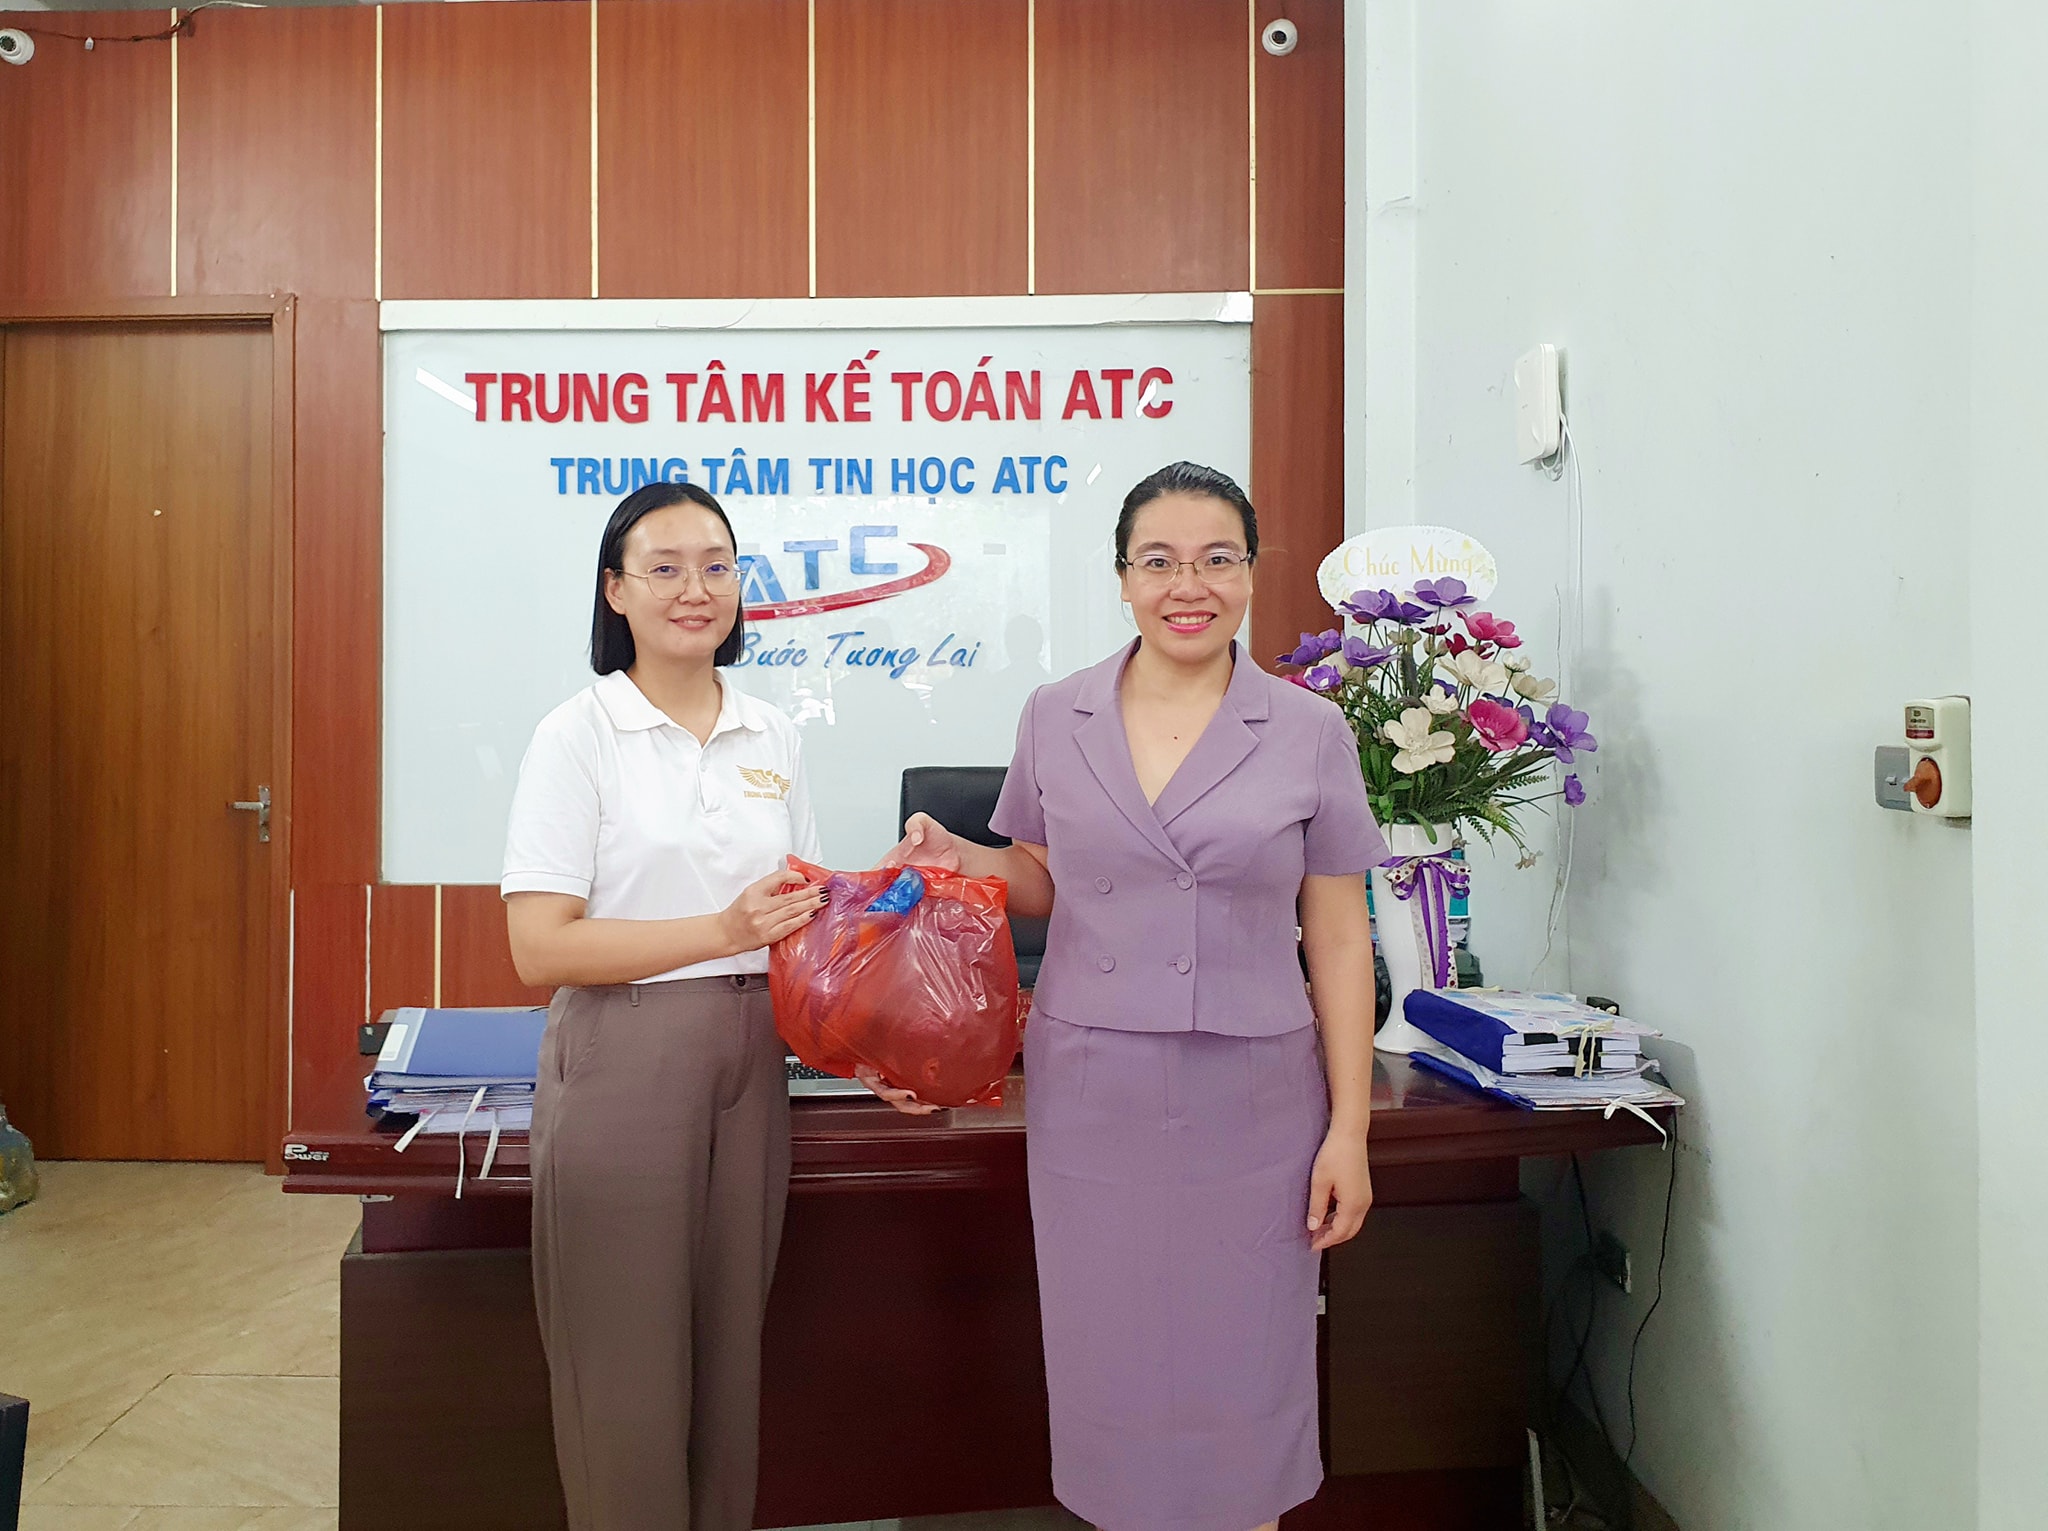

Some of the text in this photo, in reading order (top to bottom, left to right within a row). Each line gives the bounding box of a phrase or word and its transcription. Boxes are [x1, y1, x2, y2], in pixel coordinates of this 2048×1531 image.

[465, 349, 1175, 423] TRUNG TÂM KẾ TOÁN ATC
[702, 447, 789, 494] TÂM
[808, 457, 873, 494] TIN
[891, 456, 975, 504] HỌC
[992, 455, 1068, 494] ATC
[737, 525, 898, 603] ATC
[1343, 544, 1474, 577] Chúc Mừng
[926, 632, 981, 668] Lai
